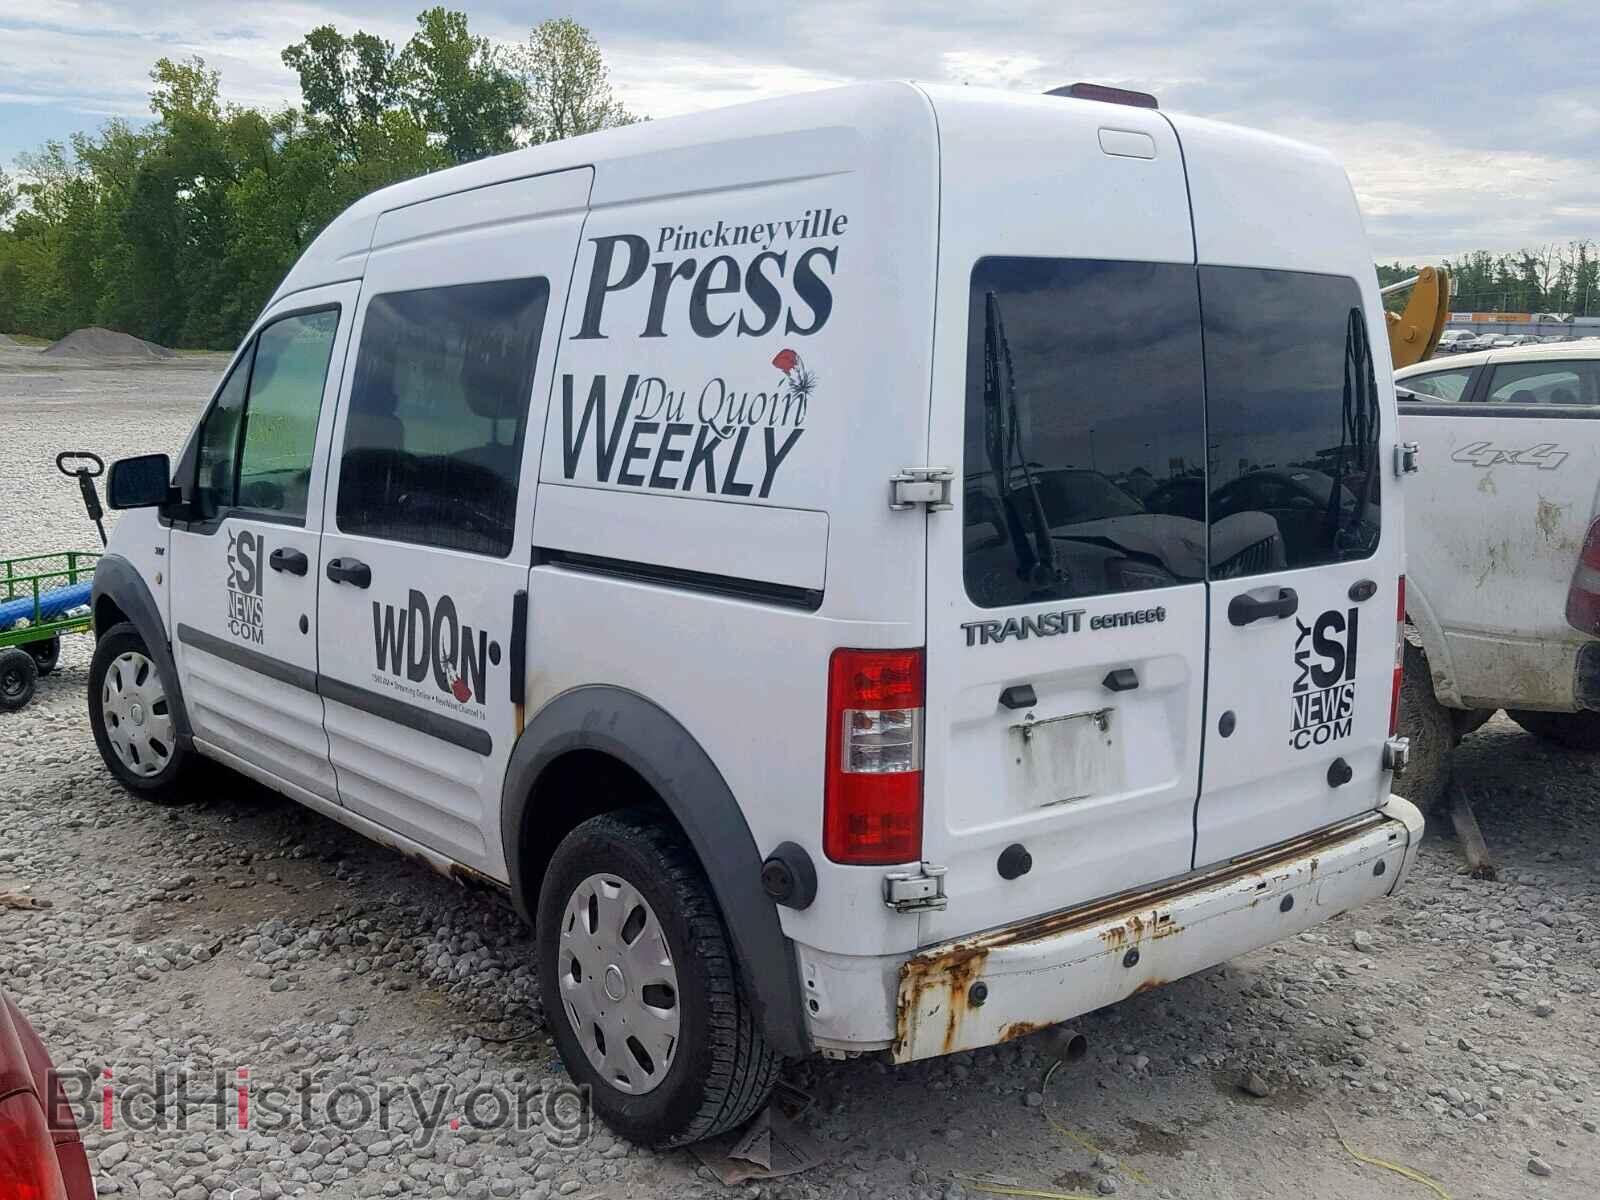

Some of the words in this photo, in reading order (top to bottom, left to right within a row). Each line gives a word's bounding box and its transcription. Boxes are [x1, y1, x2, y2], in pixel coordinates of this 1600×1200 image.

[656, 208, 849, 252] Pinckneyville
[569, 234, 839, 340] Press
[562, 373, 806, 499] WEEKLY
[633, 376, 687, 422] Du
[697, 376, 808, 440] Quoin
[1450, 441, 1569, 470] 4x4
[235, 530, 265, 597] SI
[227, 589, 264, 628] NEWS
[960, 608, 1087, 647] TRANSIT
[1090, 606, 1166, 630] connect
[1310, 606, 1359, 689] SI
[1291, 683, 1355, 732] NEWS
